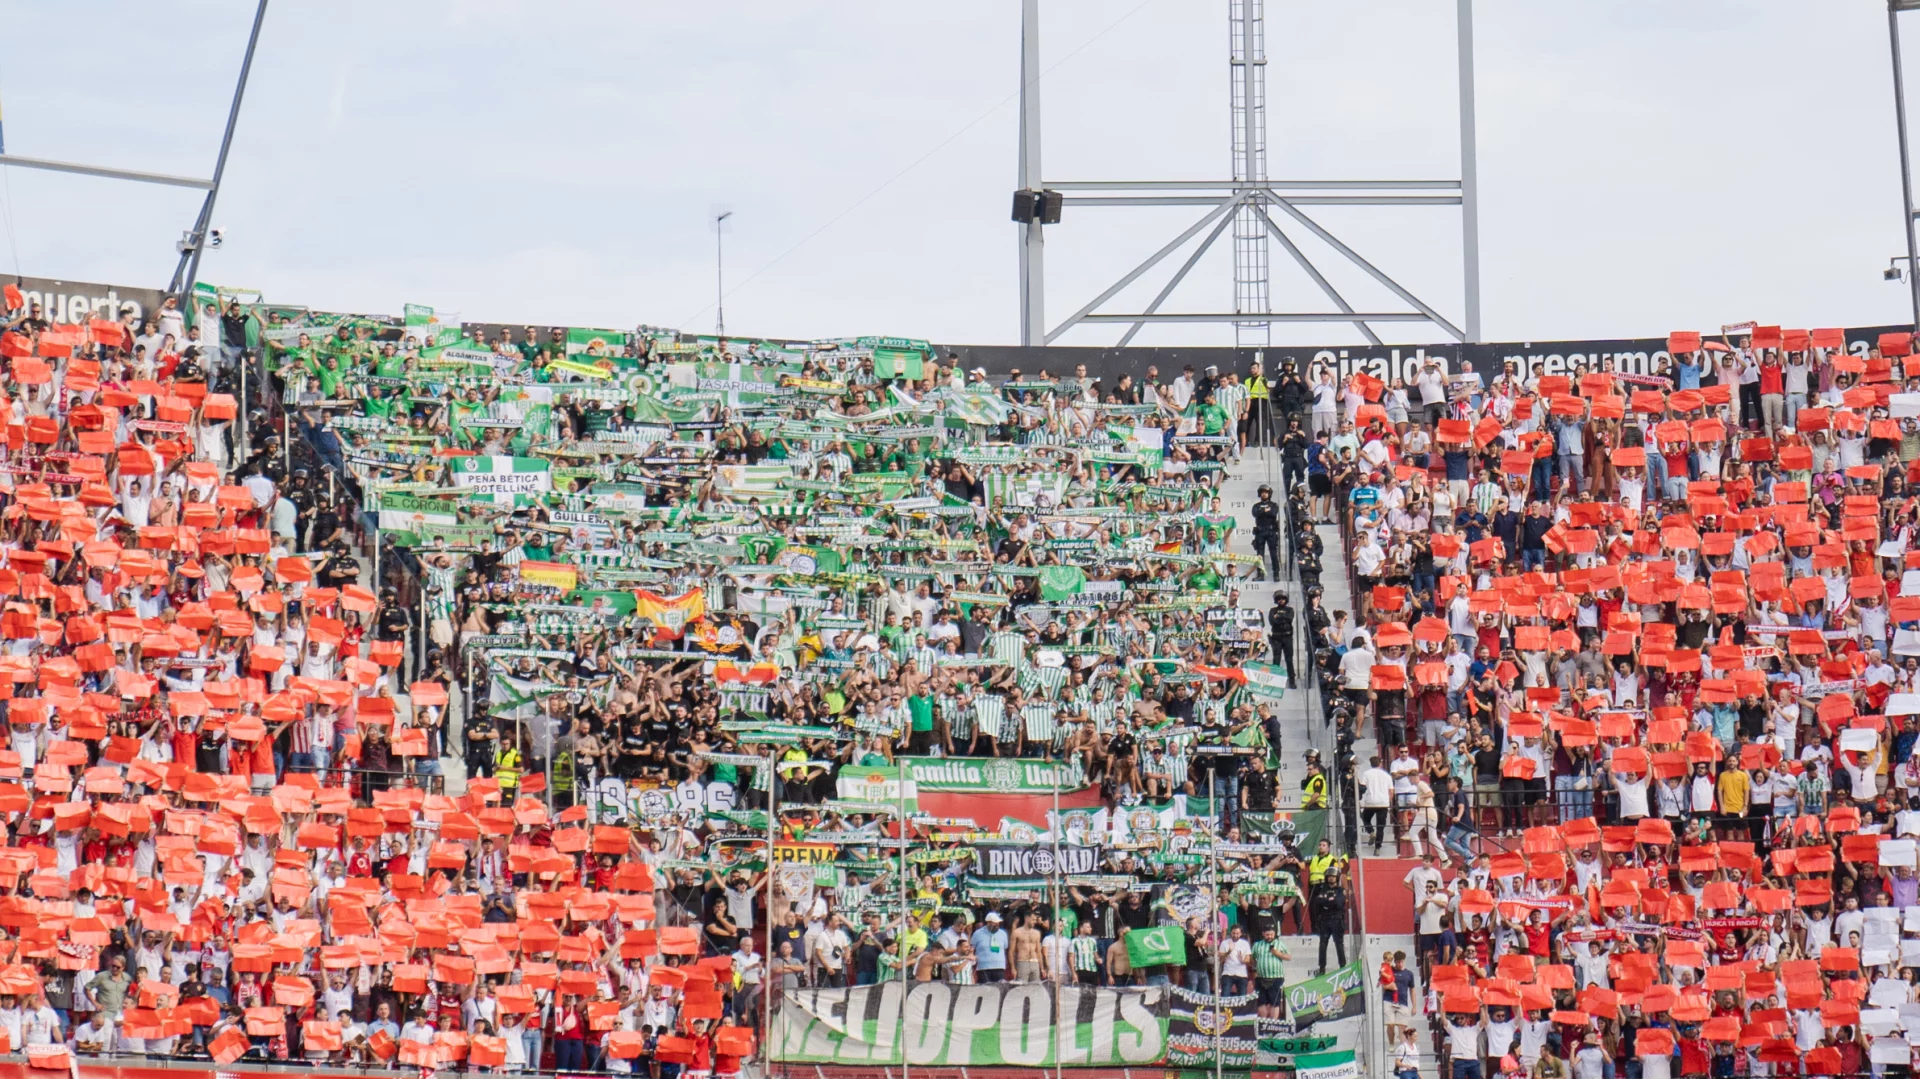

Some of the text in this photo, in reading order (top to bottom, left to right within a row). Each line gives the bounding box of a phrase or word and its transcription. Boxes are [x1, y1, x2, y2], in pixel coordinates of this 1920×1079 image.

[446, 350, 488, 361] ALGÁMITAS
[1313, 350, 1448, 388] Giralda
[530, 412, 548, 424] alé
[468, 474, 539, 484] PEÑA BÉTICA
[753, 542, 770, 555] 10
[1053, 541, 1091, 549] CAMPEÓN
[1160, 854, 1195, 862] LOPERA
[1291, 985, 1317, 1011] On
[1270, 1041, 1326, 1050] LORA
